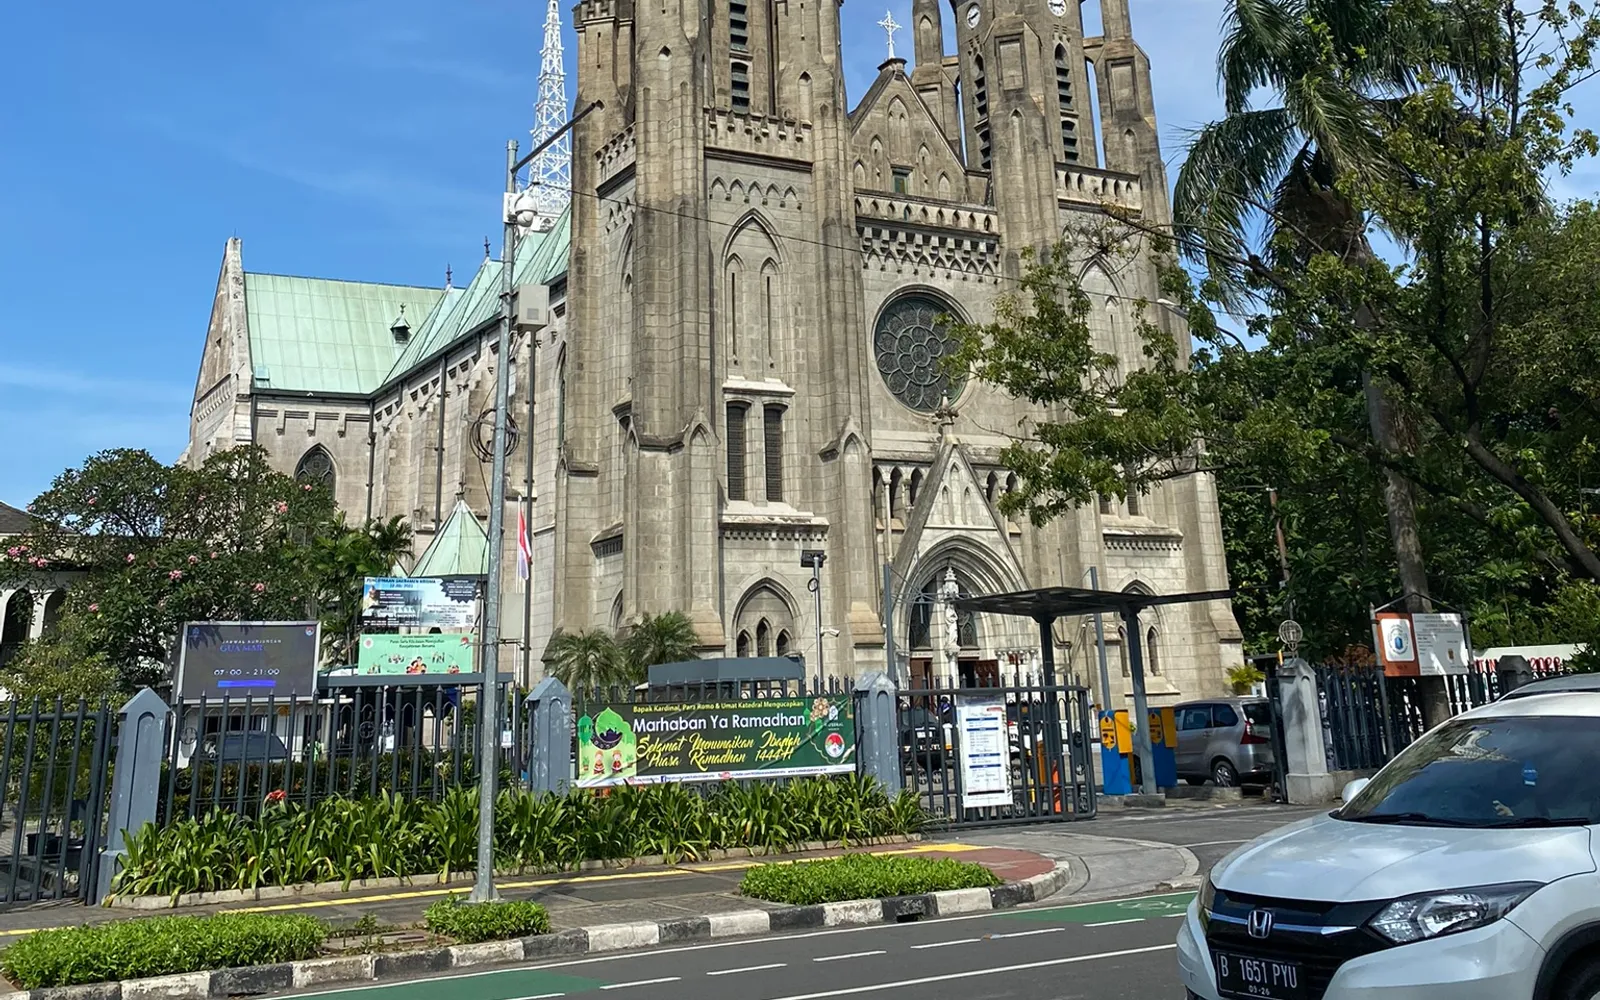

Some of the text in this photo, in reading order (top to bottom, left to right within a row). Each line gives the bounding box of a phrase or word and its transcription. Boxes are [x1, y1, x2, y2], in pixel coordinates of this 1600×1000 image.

[220, 644, 240, 652] GUA
[253, 668, 280, 676] 21:00
[633, 705, 652, 714] Bapak
[738, 701, 762, 709] Katedral
[764, 699, 804, 709] Mengucapkan
[633, 712, 805, 732] Marhaban Ya Ramadhan
[636, 730, 801, 758] Selamat Menunaikan Ibadah
[646, 746, 794, 772] Puasa Ramadhan 1444H
[1220, 955, 1298, 989] B 1651 PYU
